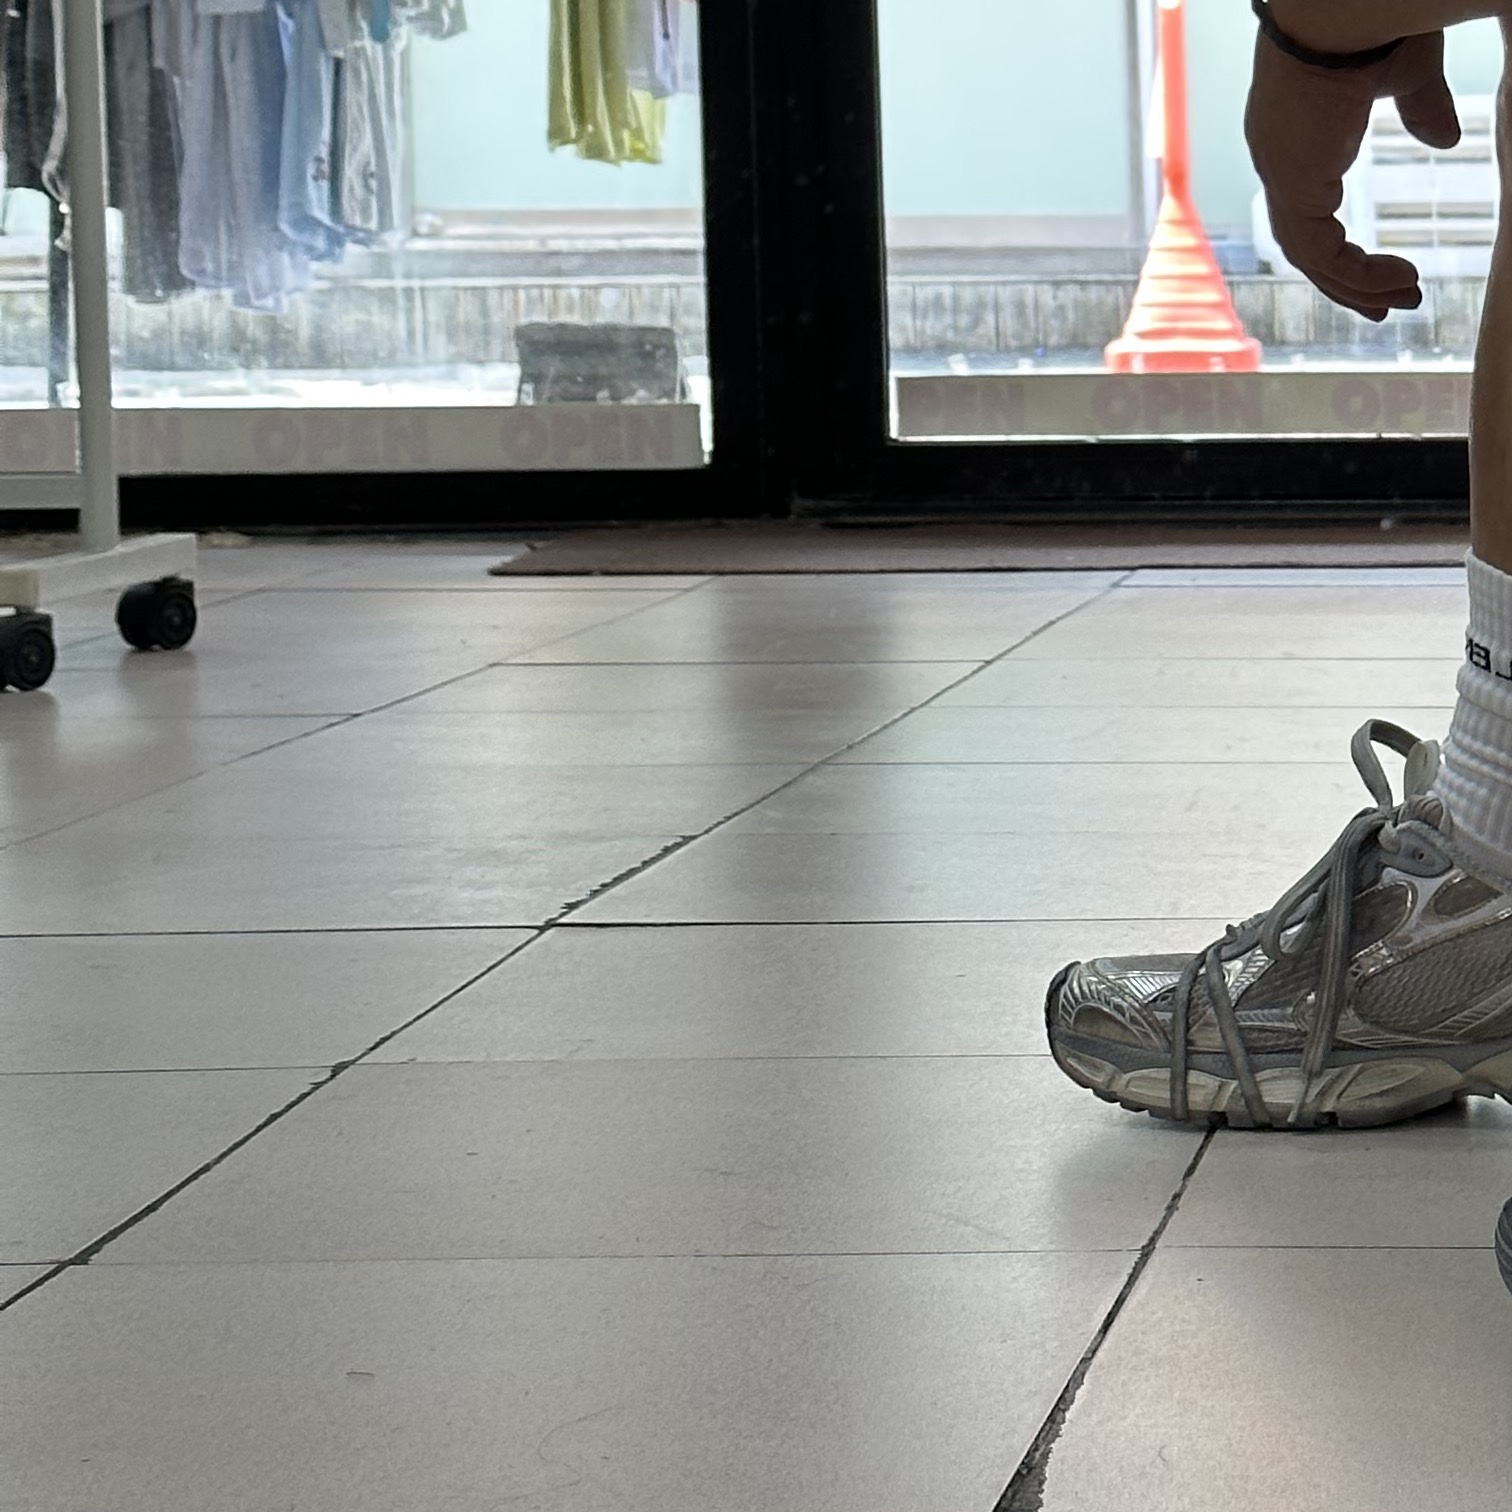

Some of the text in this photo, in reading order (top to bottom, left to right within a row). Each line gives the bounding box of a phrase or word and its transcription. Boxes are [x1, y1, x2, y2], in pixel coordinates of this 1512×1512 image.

[1094, 379, 1260, 426] OPEN
[1332, 379, 1471, 426] OPE
[500, 409, 672, 463] OPEN
